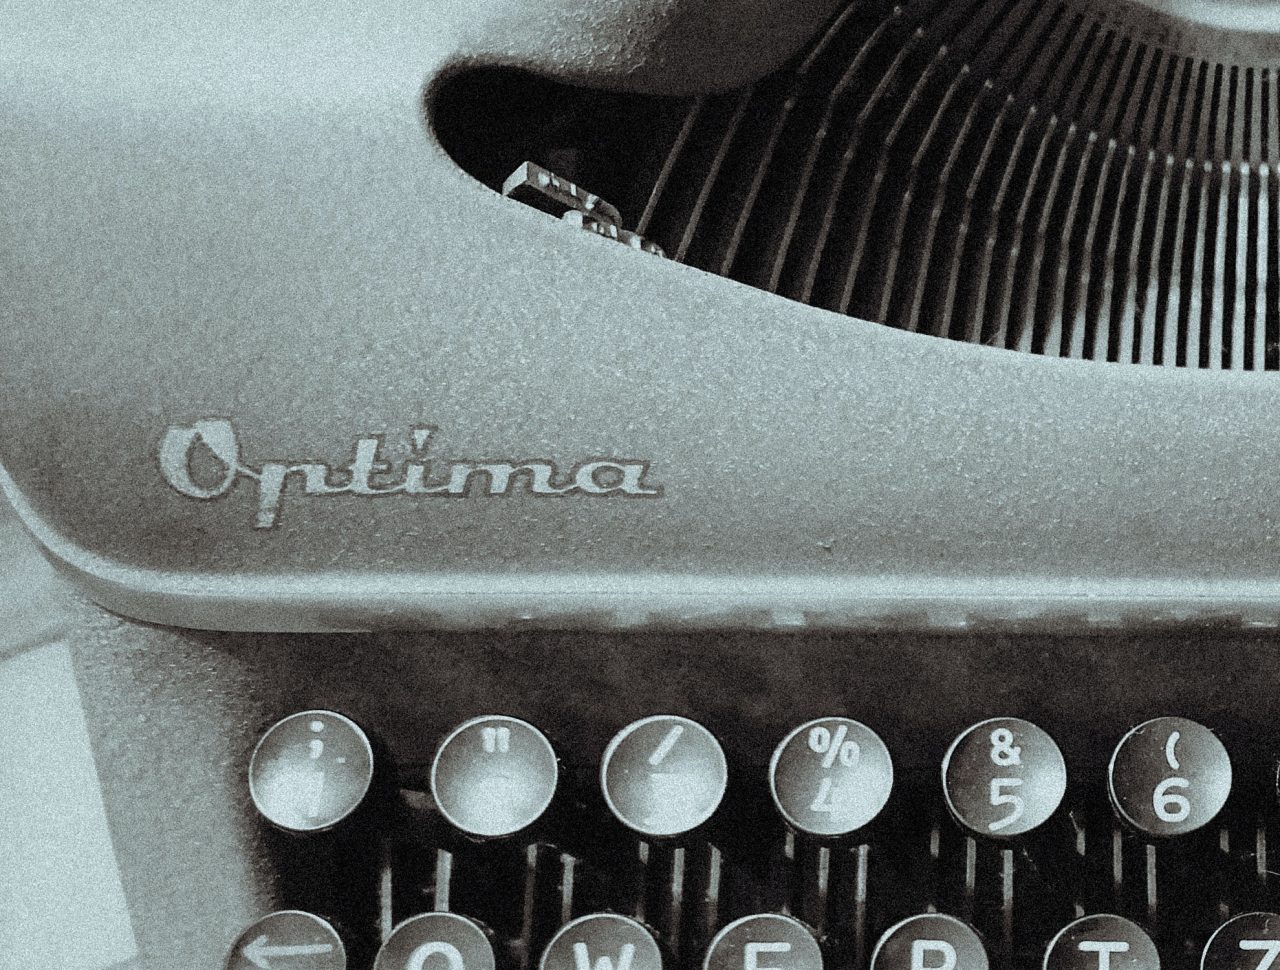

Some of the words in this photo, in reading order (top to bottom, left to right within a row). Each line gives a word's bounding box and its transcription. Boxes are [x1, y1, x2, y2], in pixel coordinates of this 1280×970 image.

[157, 418, 657, 530] Optima
[807, 724, 861, 769] %
[989, 727, 1022, 767] &
[1165, 730, 1181, 770] (
[987, 777, 1025, 832] 5
[1152, 776, 1191, 823] 6
